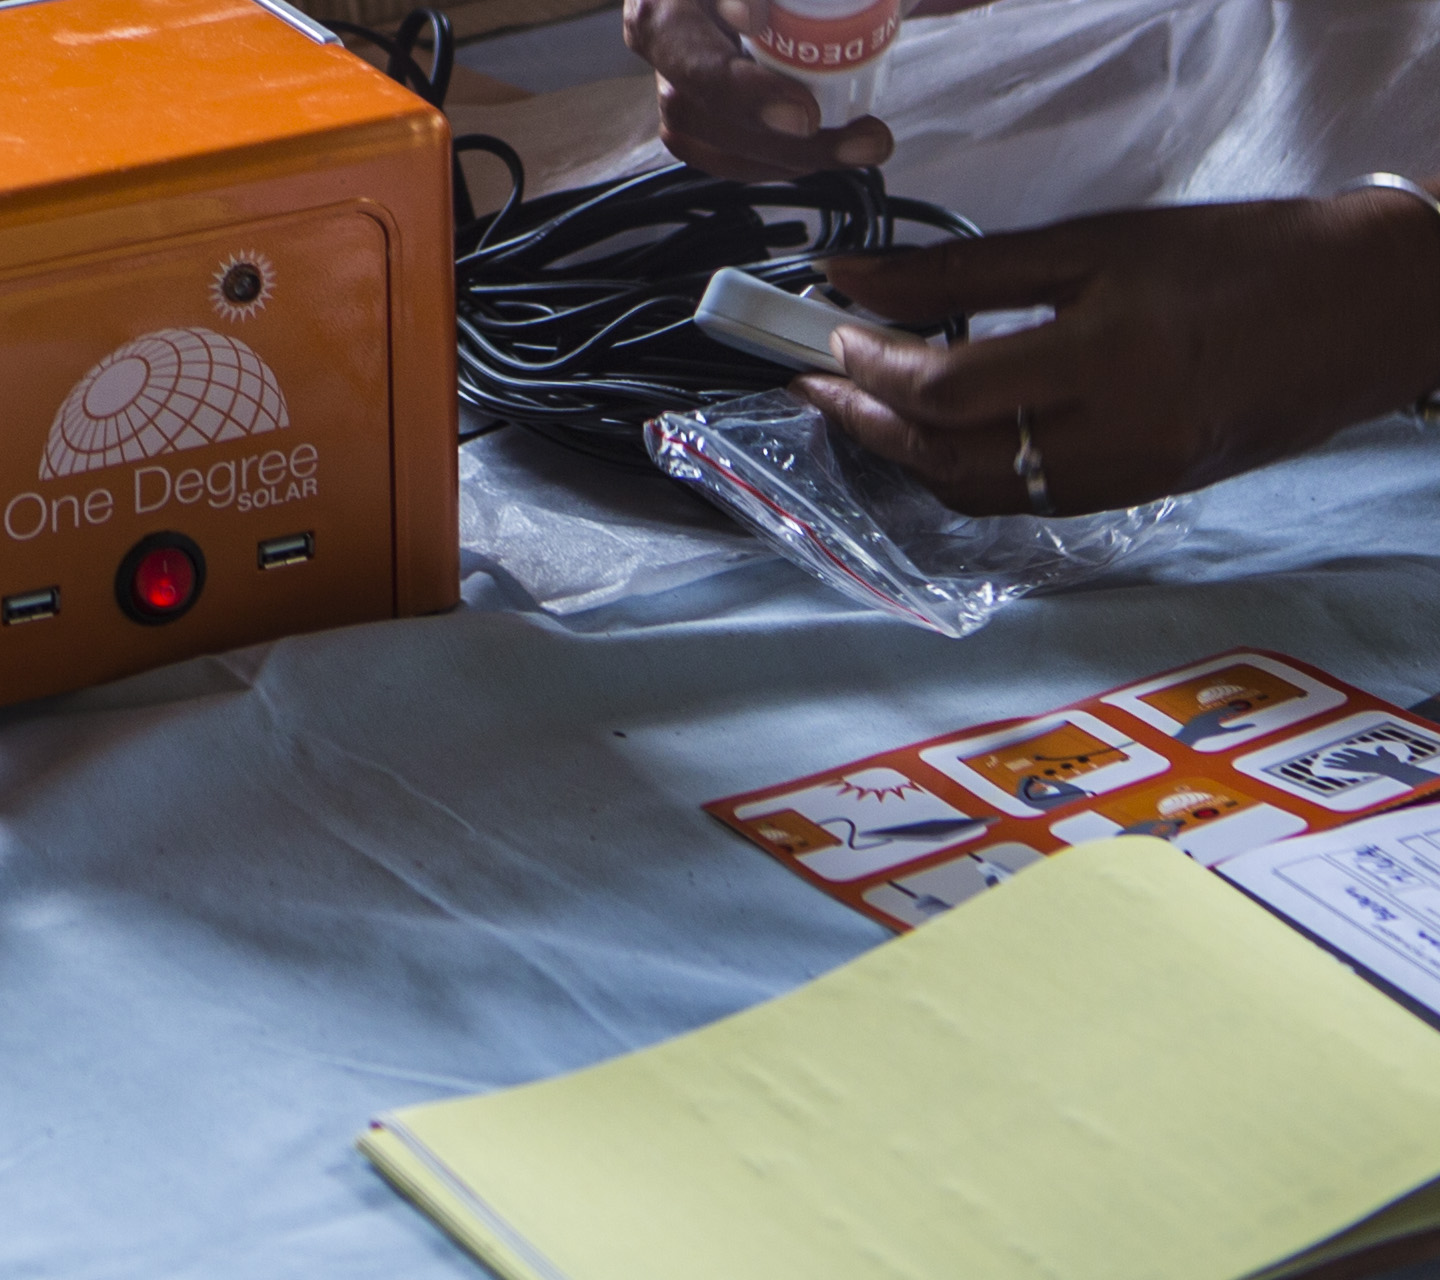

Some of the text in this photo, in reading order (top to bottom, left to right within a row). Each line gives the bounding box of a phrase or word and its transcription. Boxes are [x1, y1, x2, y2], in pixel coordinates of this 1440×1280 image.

[4, 443, 318, 540] One Degree
[238, 478, 318, 512] SOLAR
